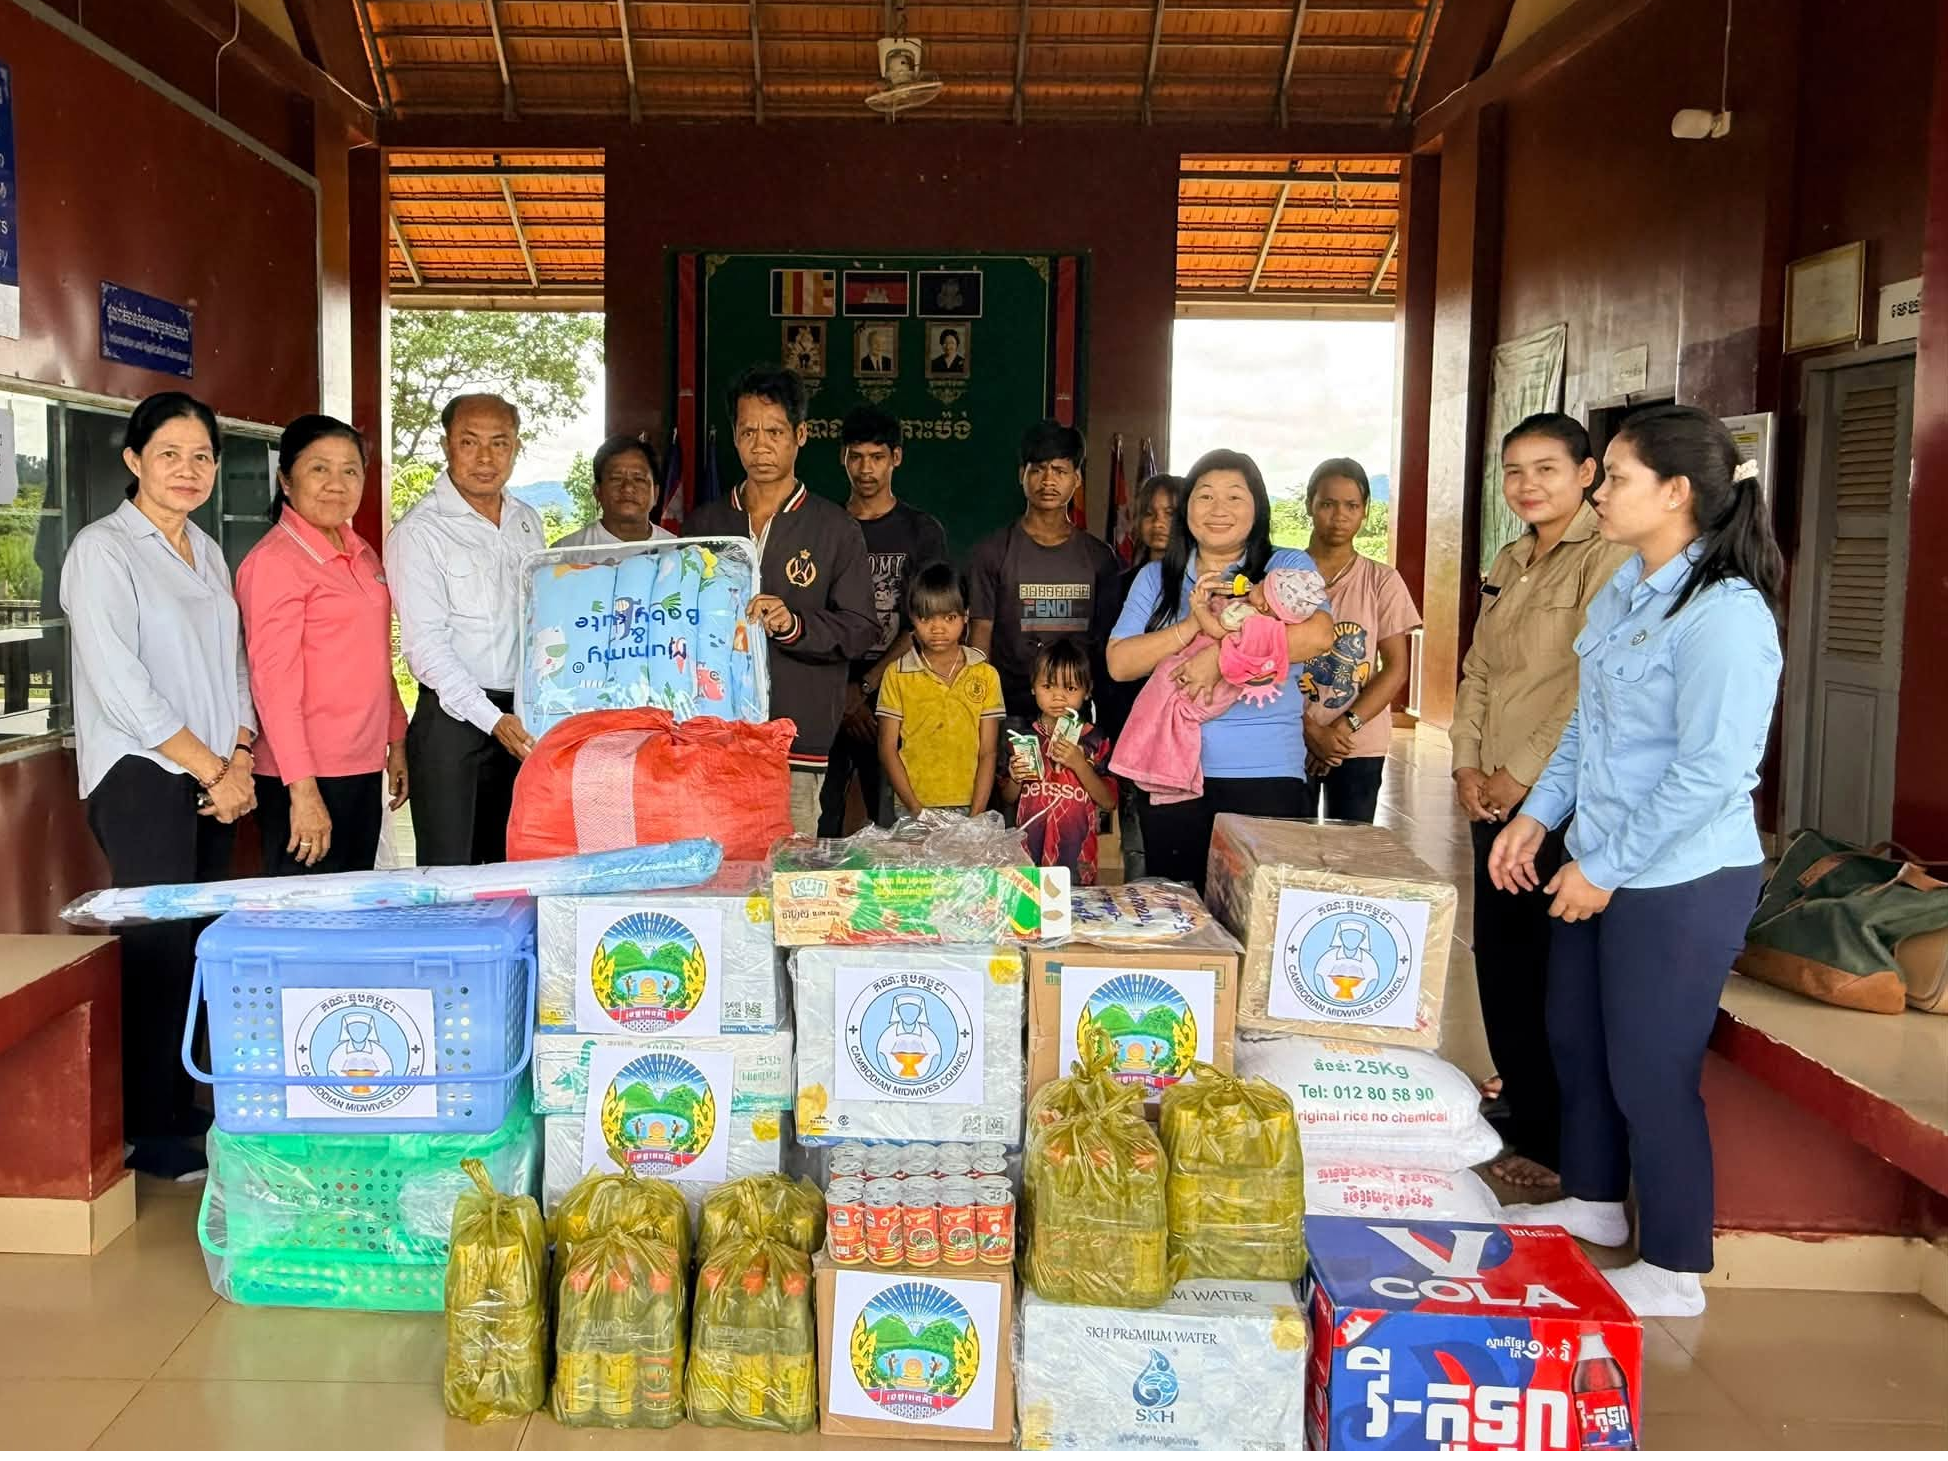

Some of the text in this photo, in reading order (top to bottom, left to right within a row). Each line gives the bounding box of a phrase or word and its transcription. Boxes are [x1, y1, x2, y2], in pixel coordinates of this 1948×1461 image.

[635, 608, 700, 625] Baby
[1023, 600, 1072, 617] FENDI
[630, 627, 646, 643] &
[588, 644, 687, 664] Mummy
[1288, 964, 1405, 1017] CAMBODIAN MIDWIVES COUNCIL
[850, 1045, 969, 1097] CAMBODIAN MIDWIVES COUNCIL
[1354, 1060, 1410, 1080] 25Kg
[1298, 1084, 1434, 1101] Tel: 012 80 58 90
[345, 1096, 394, 1112] MIDWIVES
[1297, 1110, 1448, 1124] riginal rice no chemical
[1366, 1226, 1494, 1279] V
[1191, 1290, 1254, 1303] WATER
[1370, 1277, 1580, 1310] COLA
[1086, 1326, 1219, 1345] SKH PREMIUM WATER
[1135, 1408, 1174, 1424] SKH
